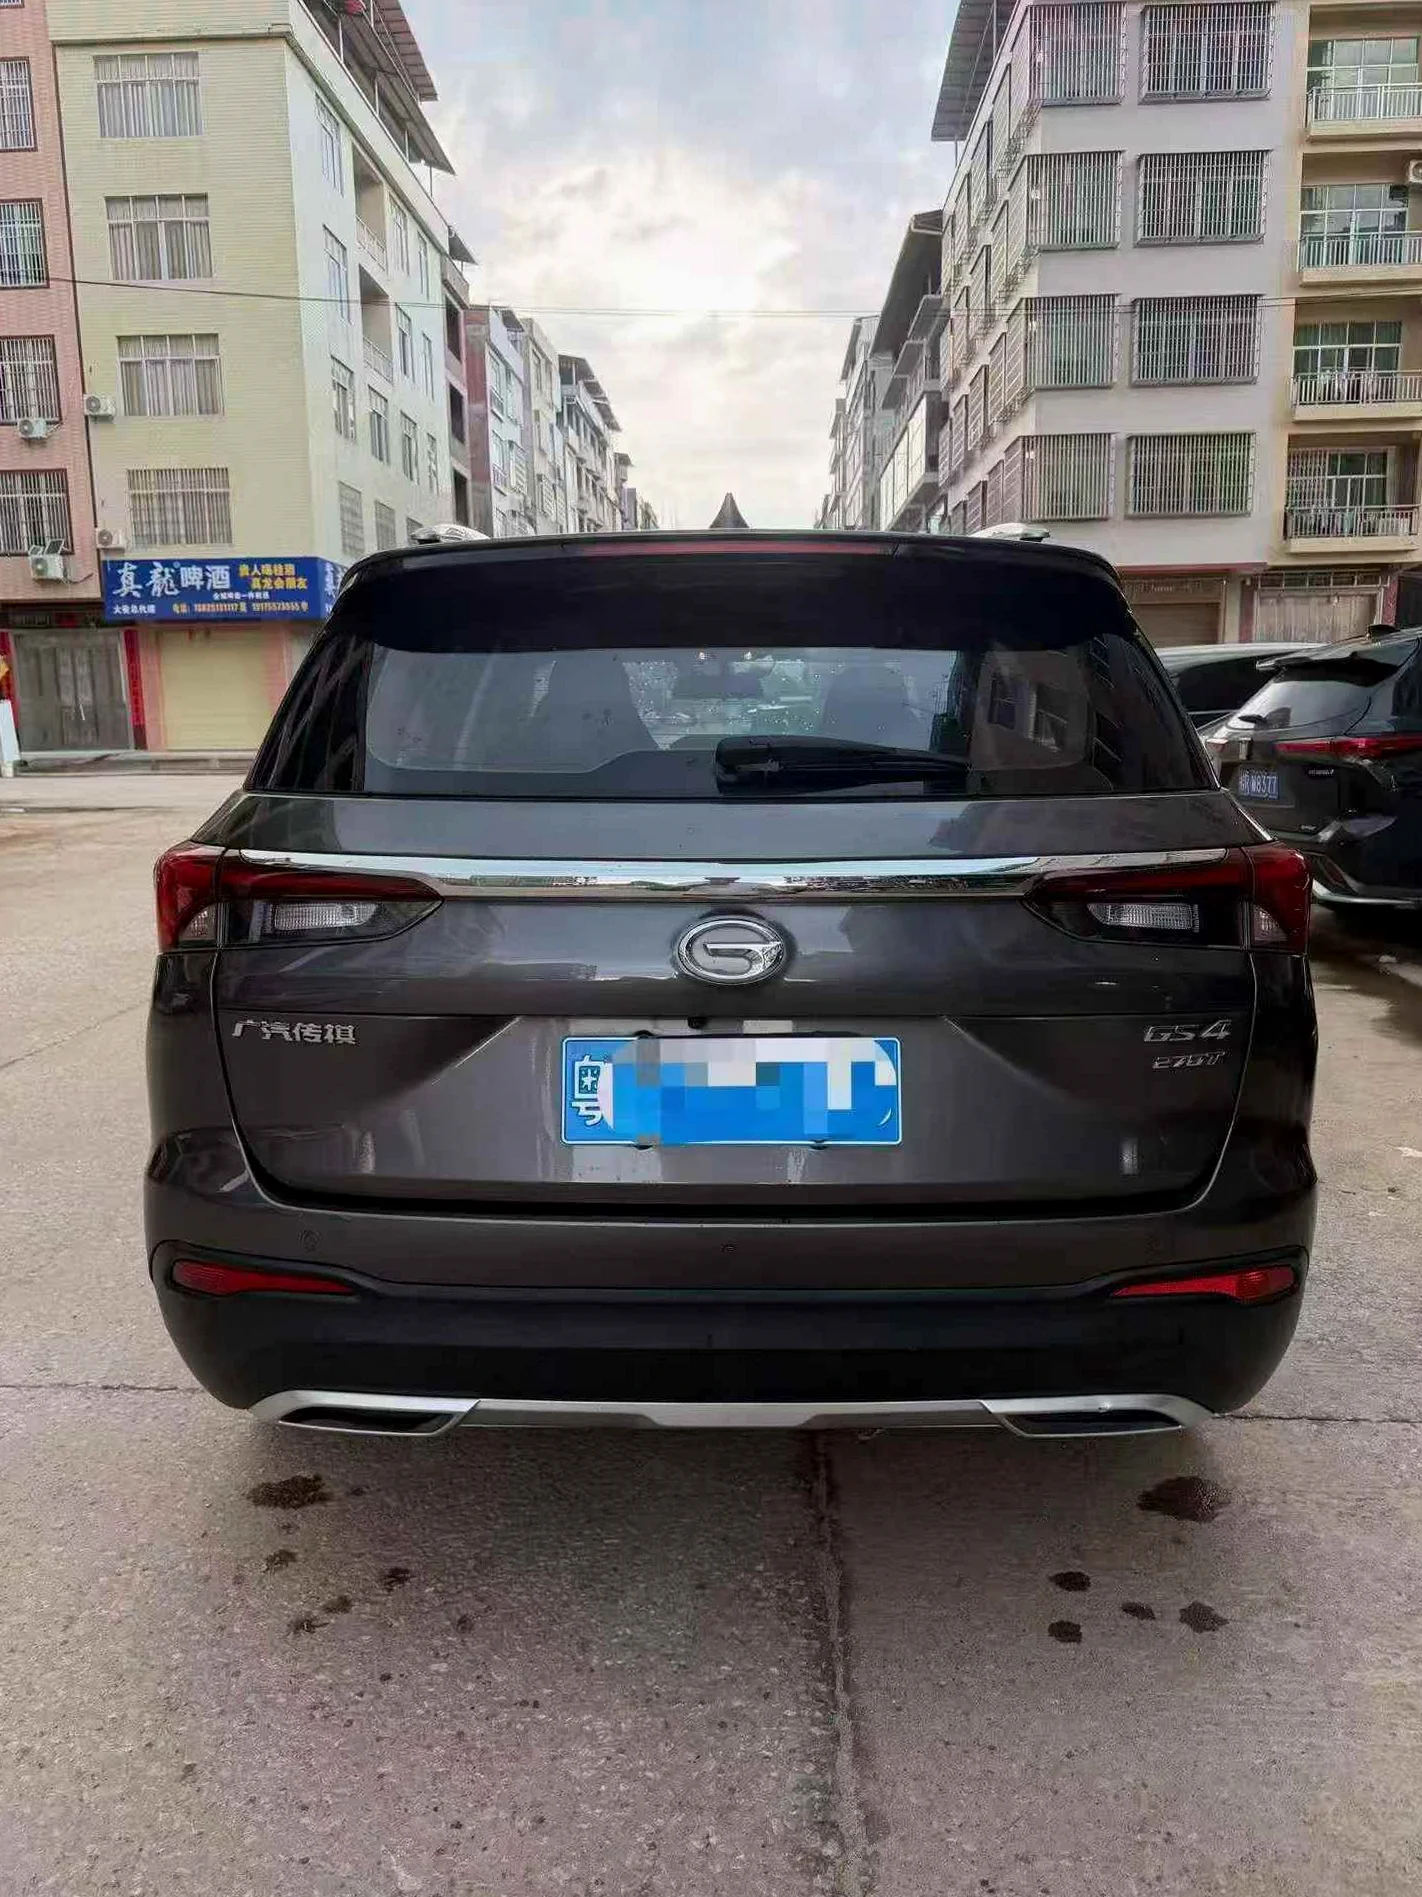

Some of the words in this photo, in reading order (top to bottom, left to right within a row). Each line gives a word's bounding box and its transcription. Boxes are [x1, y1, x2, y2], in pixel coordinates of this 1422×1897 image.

[231, 1019, 356, 1045] 广汽传祺
[1143, 1019, 1231, 1041] GS4
